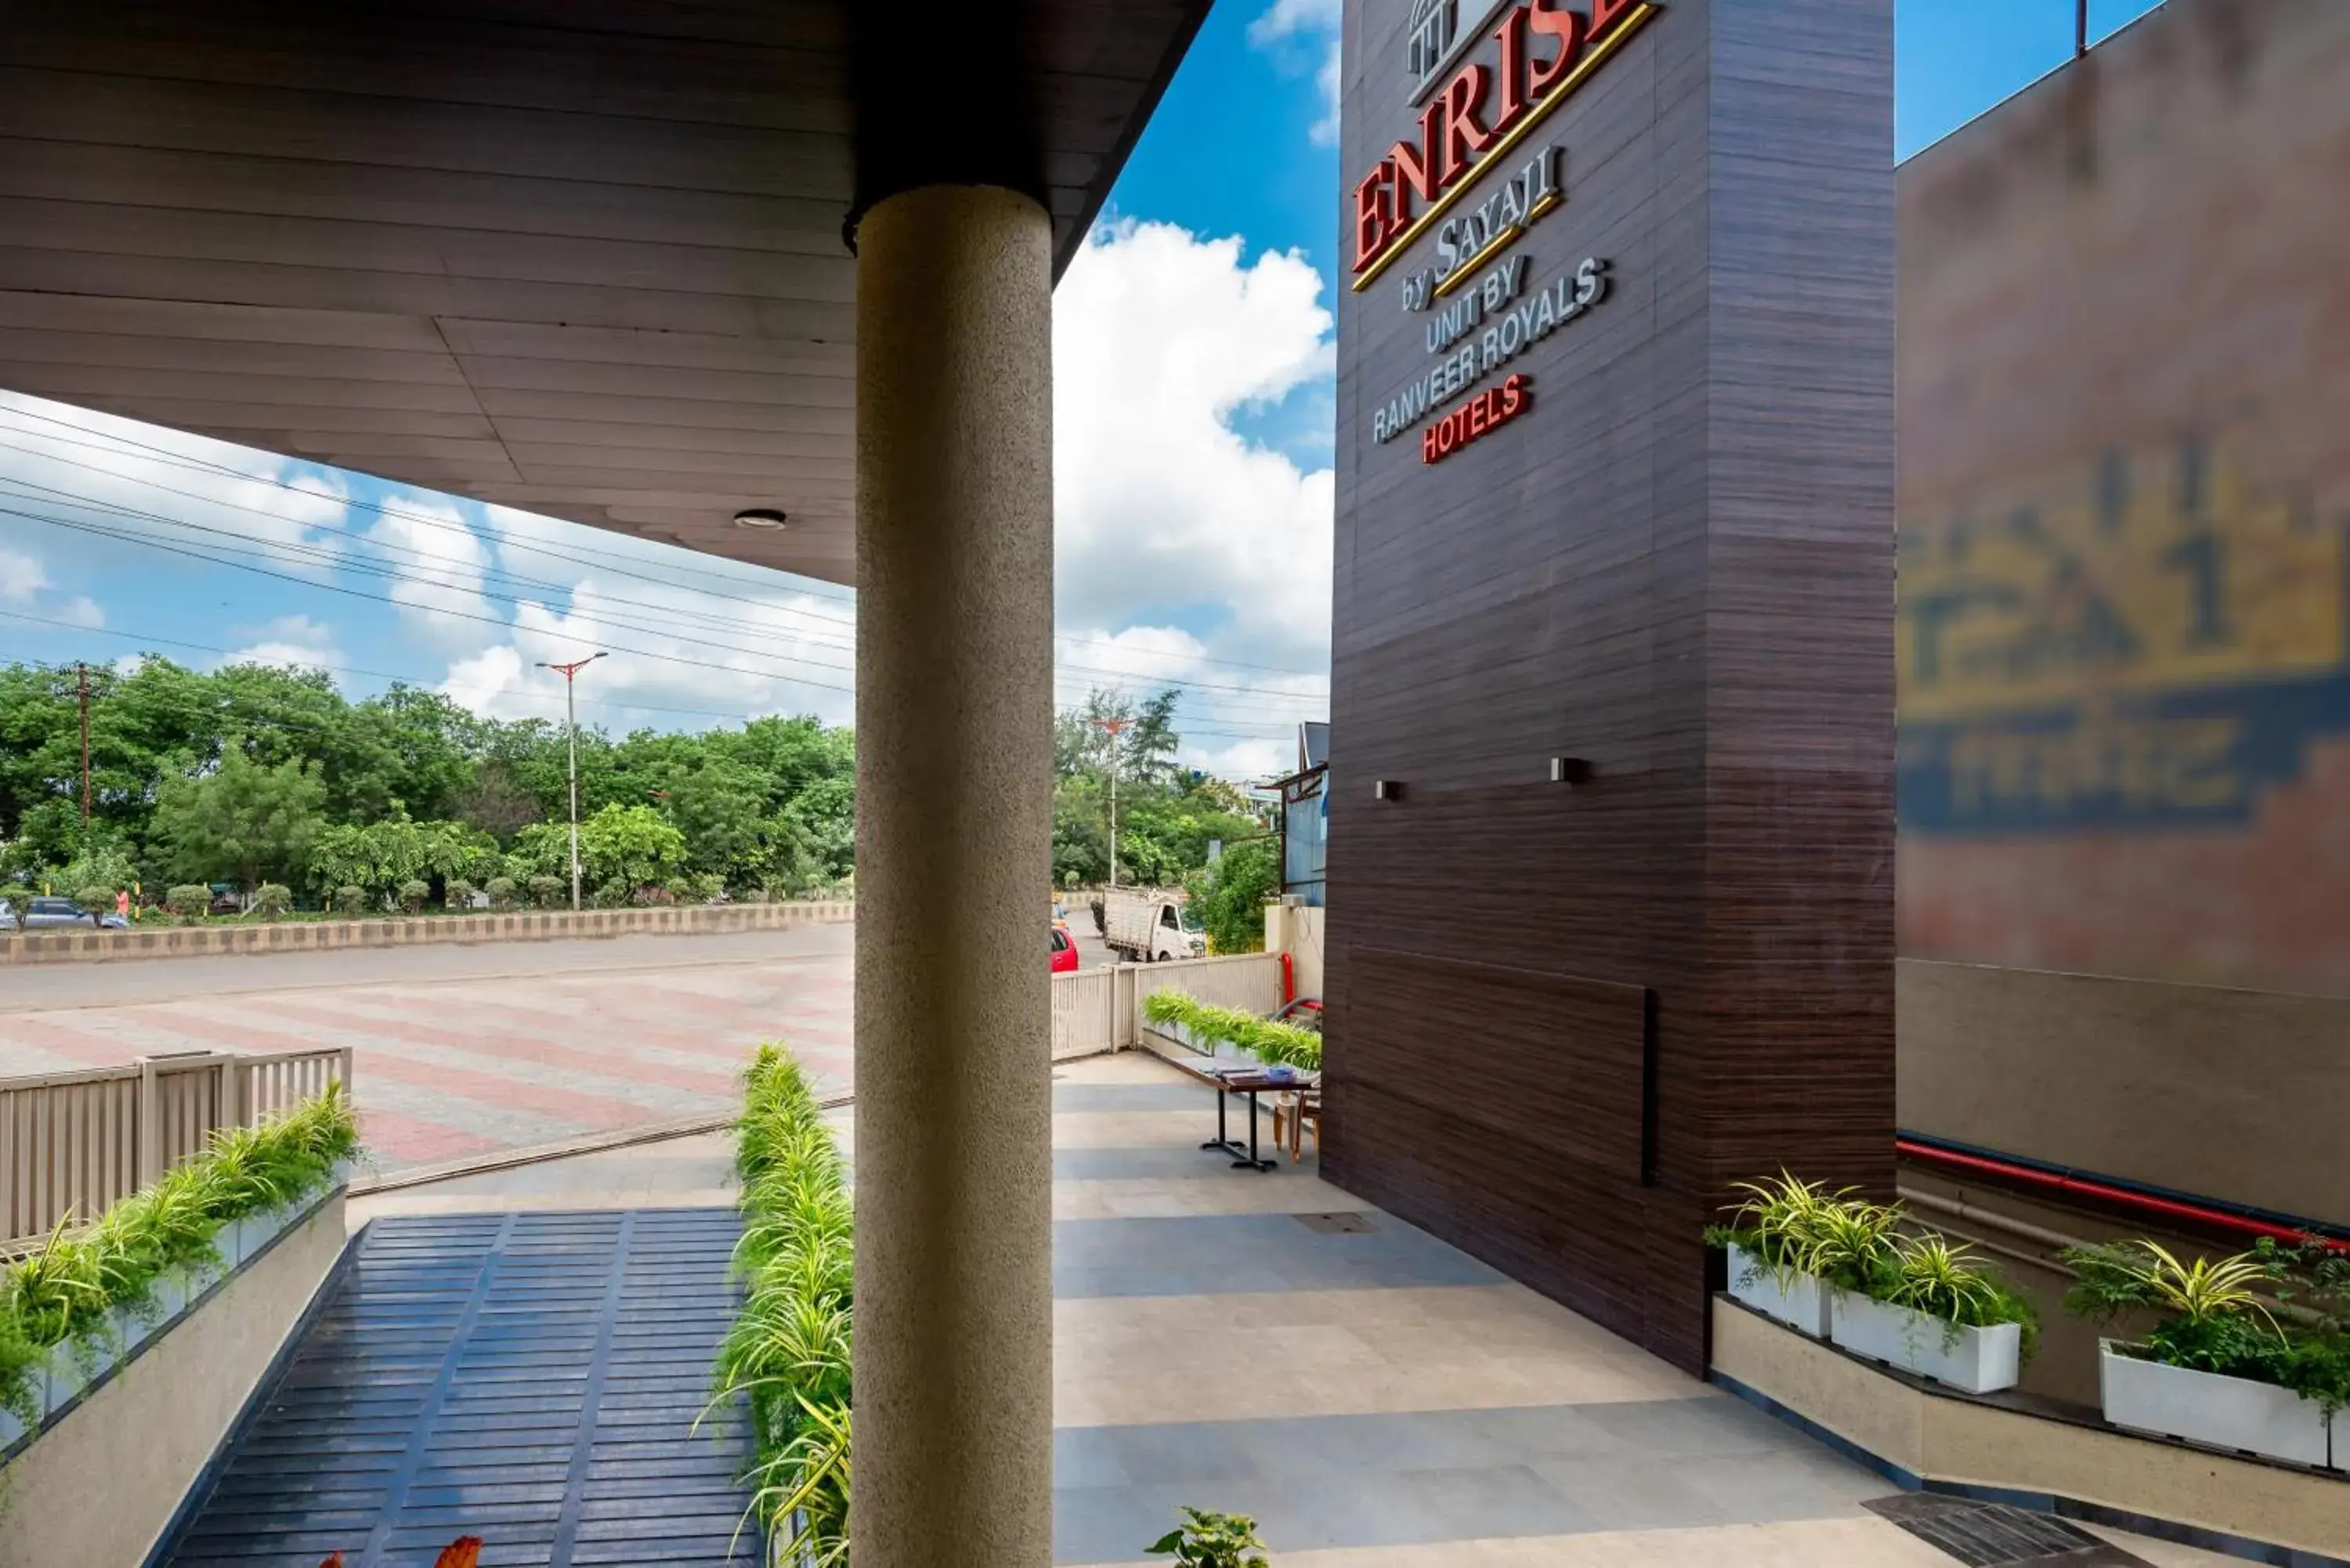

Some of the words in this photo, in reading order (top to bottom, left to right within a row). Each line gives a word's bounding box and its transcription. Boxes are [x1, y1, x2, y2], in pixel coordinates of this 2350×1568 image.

[1434, 145, 1557, 283] SAYAJI
[1374, 342, 1480, 443] RANVEER
[1482, 257, 1607, 372] ROYALS
[1426, 287, 1480, 353] UNIT
[1484, 255, 1523, 313] BY
[1422, 373, 1531, 464] HOTELS
